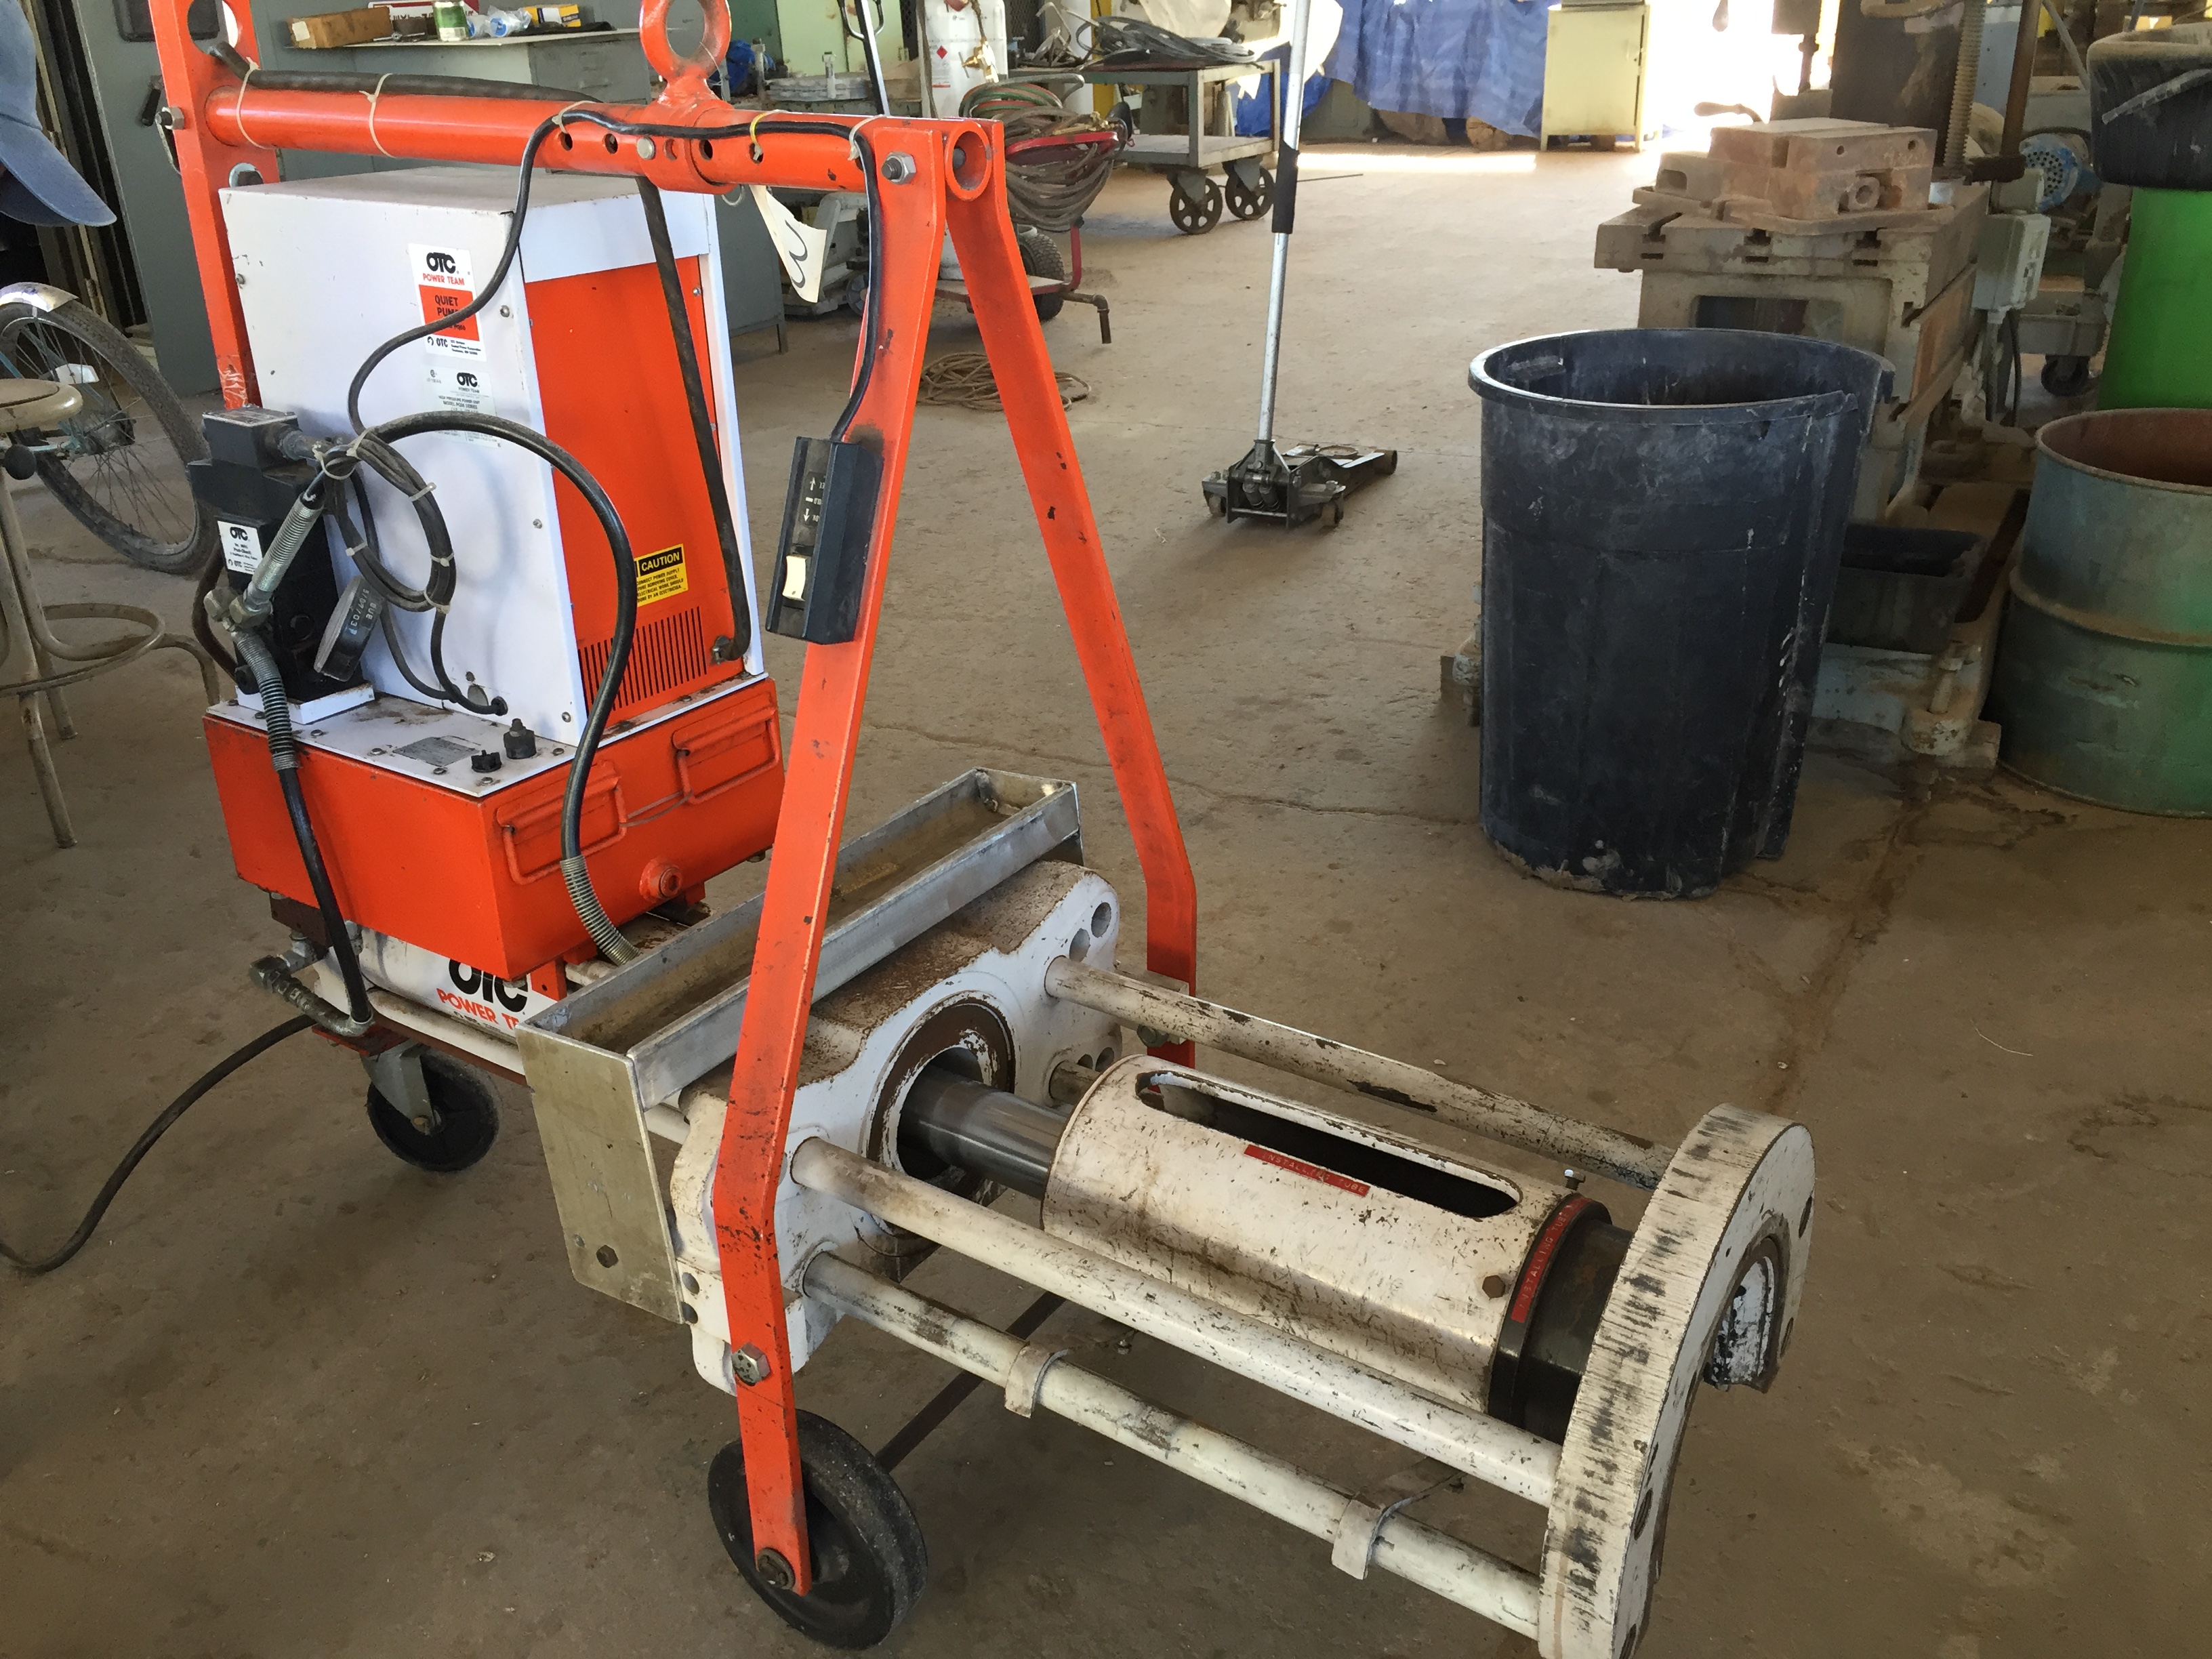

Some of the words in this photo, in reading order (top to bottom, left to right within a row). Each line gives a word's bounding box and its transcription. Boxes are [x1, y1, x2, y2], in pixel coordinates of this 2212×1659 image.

[426, 252, 456, 274] OTC
[422, 273, 445, 283] POWER
[447, 276, 464, 285] TEAM
[434, 294, 458, 306] QUIET
[436, 337, 448, 348] OTC
[457, 372, 478, 387] OTC
[230, 527, 248, 541] OTC
[641, 552, 680, 571] CAUTION
[436, 987, 499, 1025] POWER
[1338, 1179, 1366, 1193] TUBE
